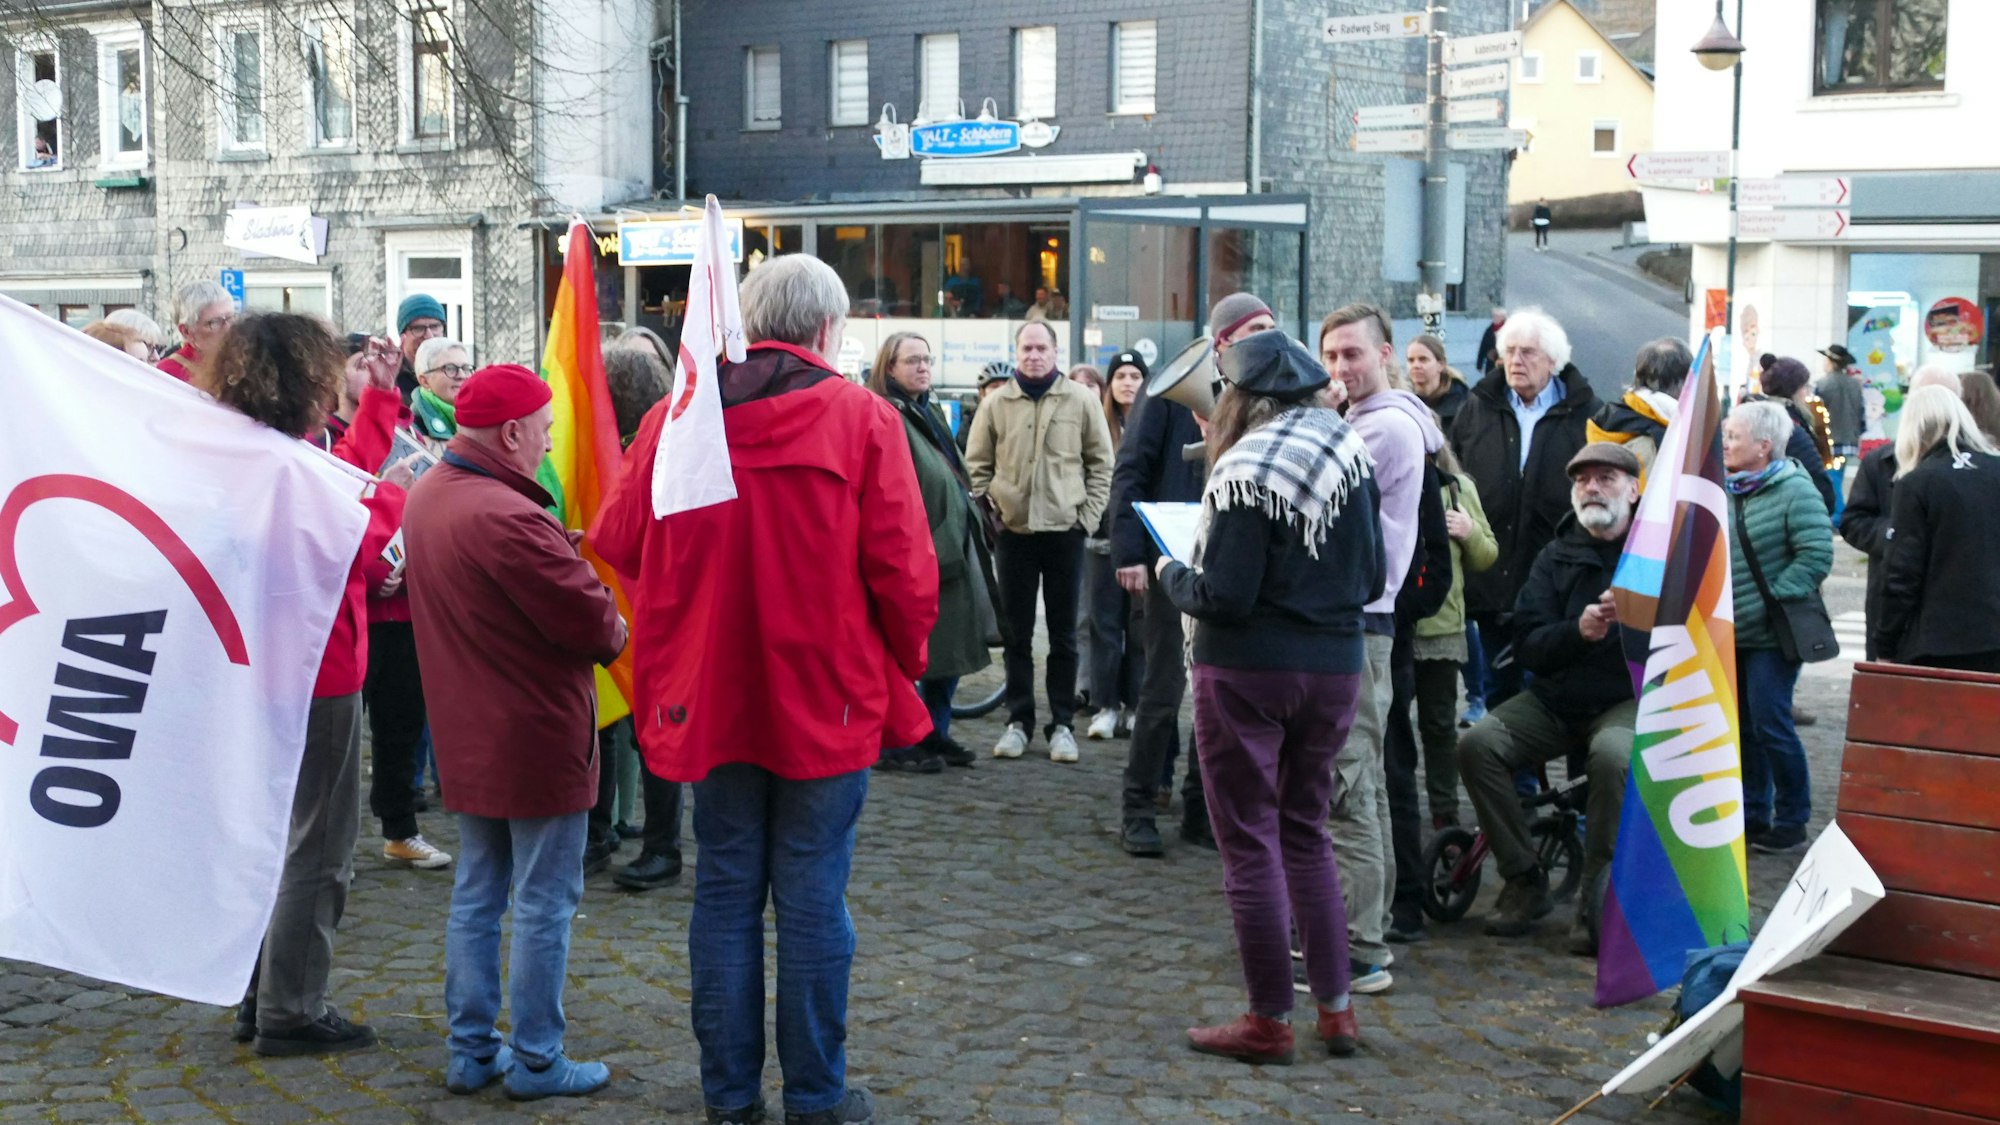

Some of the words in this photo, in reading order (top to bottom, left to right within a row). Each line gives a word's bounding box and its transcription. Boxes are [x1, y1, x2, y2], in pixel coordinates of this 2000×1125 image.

[1341, 24, 1371, 35] Radweg
[1373, 22, 1391, 33] Sieg
[1635, 625, 1745, 848] AWO
